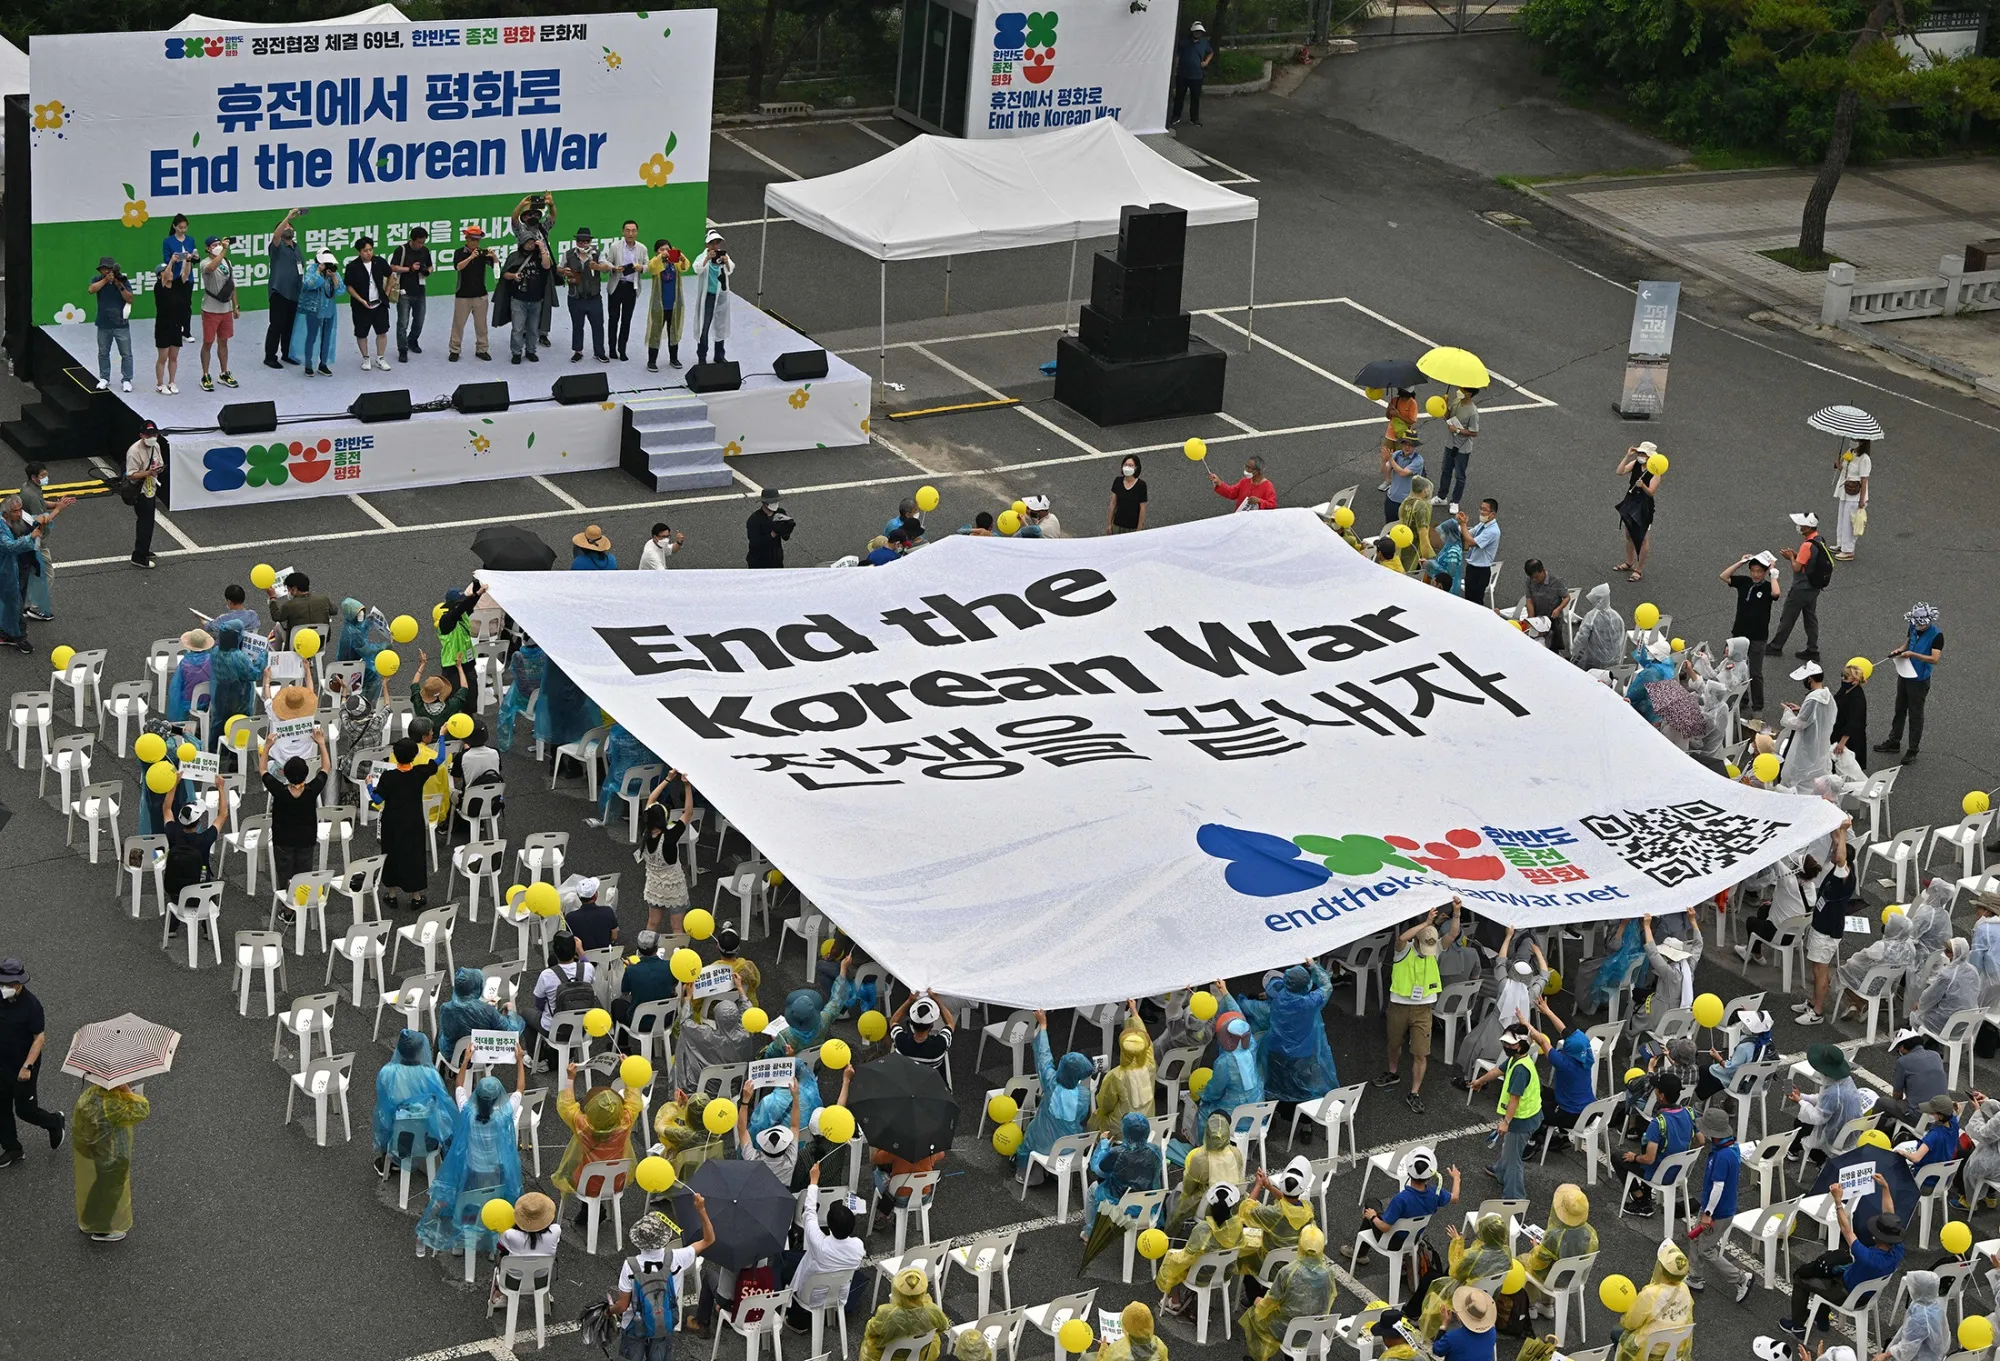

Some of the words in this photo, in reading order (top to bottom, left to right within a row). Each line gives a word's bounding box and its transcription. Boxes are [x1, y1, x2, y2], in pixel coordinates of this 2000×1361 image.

[252, 35, 319, 56] 정전협정
[325, 33, 358, 52] 체결
[412, 29, 461, 47] 한반도
[466, 27, 498, 45] 종전
[503, 26, 536, 44] 평화
[540, 23, 587, 42] 문화제
[993, 50, 1024, 61] 한반도
[992, 62, 1013, 73] 종전
[991, 74, 1012, 86] 평화
[217, 75, 408, 133] 휴전에서
[426, 68, 561, 121] 평화로
[990, 89, 1053, 110] 휴전에서
[1057, 86, 1103, 106] 평화로
[988, 111, 1014, 130] End
[1018, 109, 1040, 128] the
[1044, 107, 1091, 127] Korean
[150, 145, 239, 197] End
[254, 143, 332, 191] the
[348, 137, 506, 185] Korean
[520, 126, 608, 174] War
[334, 436, 374, 451] 한반도
[334, 451, 361, 466] 종전
[334, 466, 361, 480] 평화
[592, 614, 879, 676] End
[880, 568, 1117, 646] the
[657, 655, 1164, 739] Korean
[1144, 604, 1420, 678] War
[731, 714, 1152, 791] 전쟁을
[1144, 651, 1531, 761] 끝내자
[1481, 825, 1579, 848] 한반도
[1499, 847, 1570, 867] 종전
[1517, 864, 1590, 885] 평화
